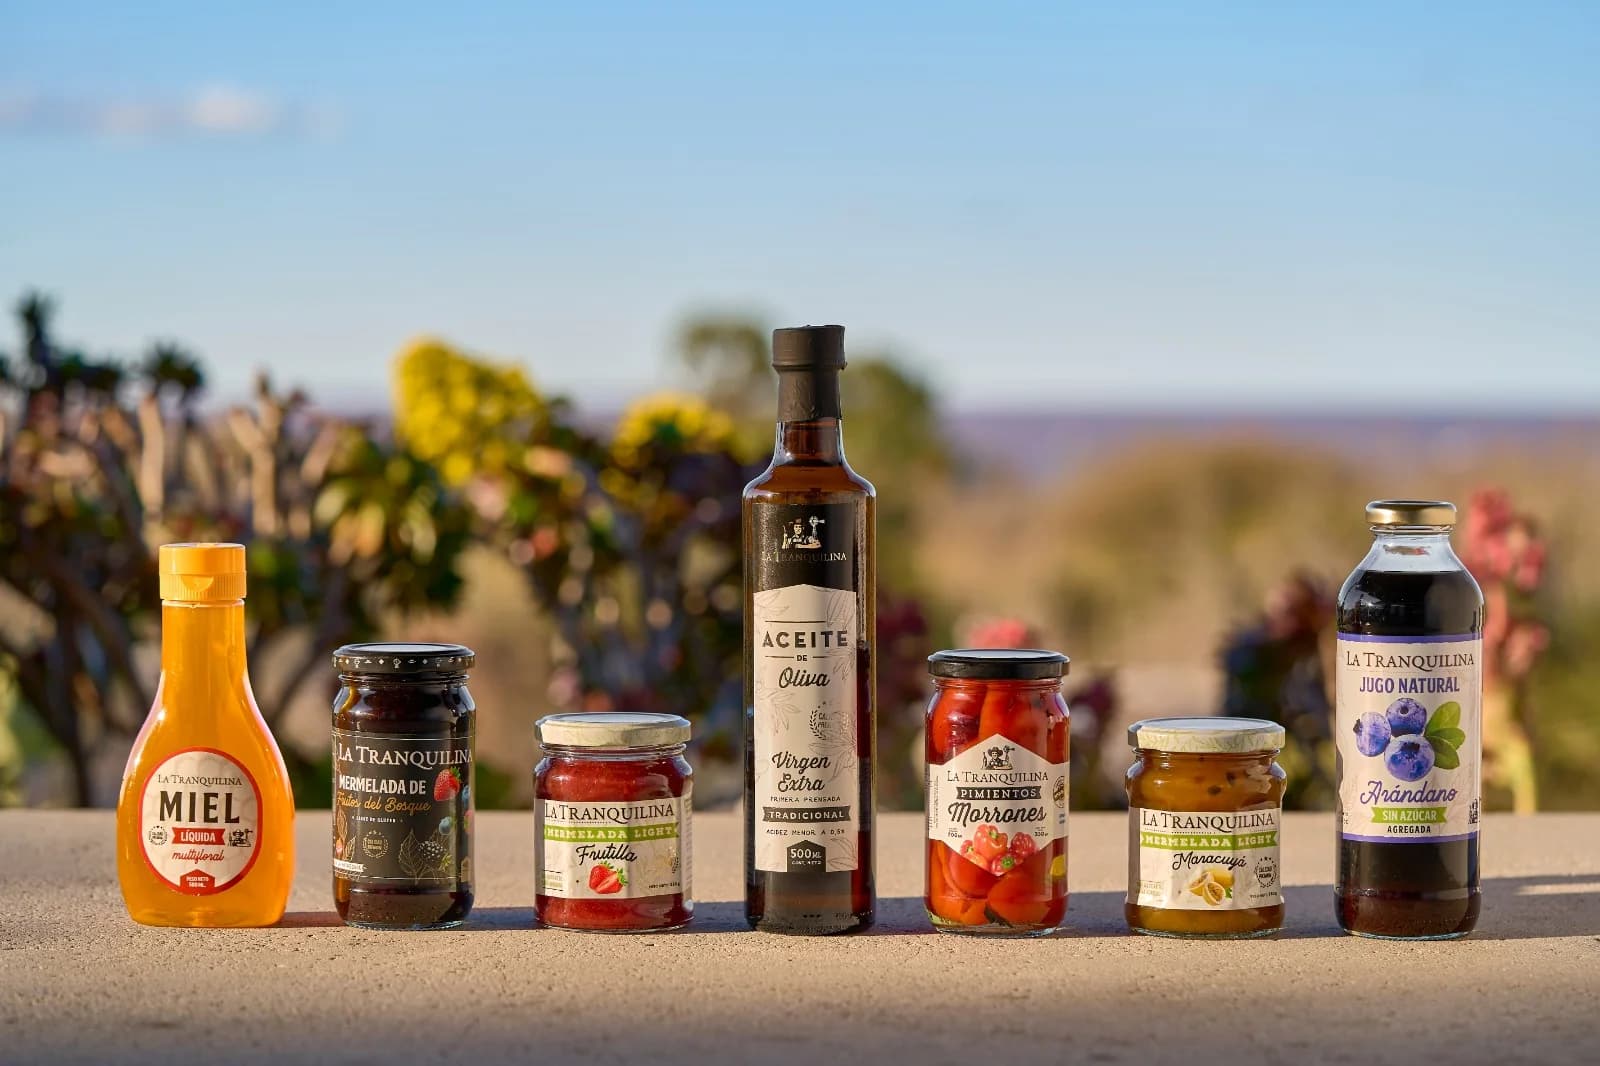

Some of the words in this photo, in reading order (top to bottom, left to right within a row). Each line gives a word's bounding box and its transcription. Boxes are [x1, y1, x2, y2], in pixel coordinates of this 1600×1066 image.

[762, 630, 849, 649] ACEITE
[796, 654, 808, 662] DE
[1347, 651, 1360, 667] LA
[1363, 652, 1474, 672] TRANQUILINA
[778, 666, 831, 689] Oliva
[1360, 677, 1395, 693] JUGO
[1398, 676, 1460, 693] NATURAL
[338, 743, 353, 761] LA
[356, 745, 473, 770] TRANQUILINA
[771, 751, 831, 774] Virgen
[157, 774, 169, 783] LA
[170, 774, 242, 787] TRANQUILINA
[339, 775, 407, 795] MERMELADA
[409, 780, 426, 795] DE
[777, 773, 826, 793] Extra
[947, 770, 959, 782] LA
[961, 771, 1049, 785] TRANQUILINA
[960, 788, 1037, 799] PIMIENTOS
[1359, 780, 1458, 804] Arándano
[159, 790, 240, 824] MIEL
[364, 796, 382, 810] del
[384, 797, 432, 816] Bosque
[545, 802, 557, 818] LA
[559, 803, 675, 824] TRANQUILINA
[769, 811, 845, 820] TRADICIONAL
[947, 802, 1047, 827] Morrones
[1383, 810, 1399, 821] SIN
[1400, 808, 1437, 822] AZÚCAR
[1143, 811, 1158, 826] LA
[1160, 812, 1275, 833] TRANQUILINA
[1387, 825, 1432, 834] AGREGADA
[180, 829, 216, 843] LÍQUIDA
[547, 827, 628, 839] MERMELADA
[634, 826, 673, 838] LIGHT
[1146, 836, 1232, 847] MERMELADA
[1238, 834, 1272, 846] LIGHT
[575, 843, 638, 866] Frutilla
[1172, 851, 1248, 871] Maracuyá
